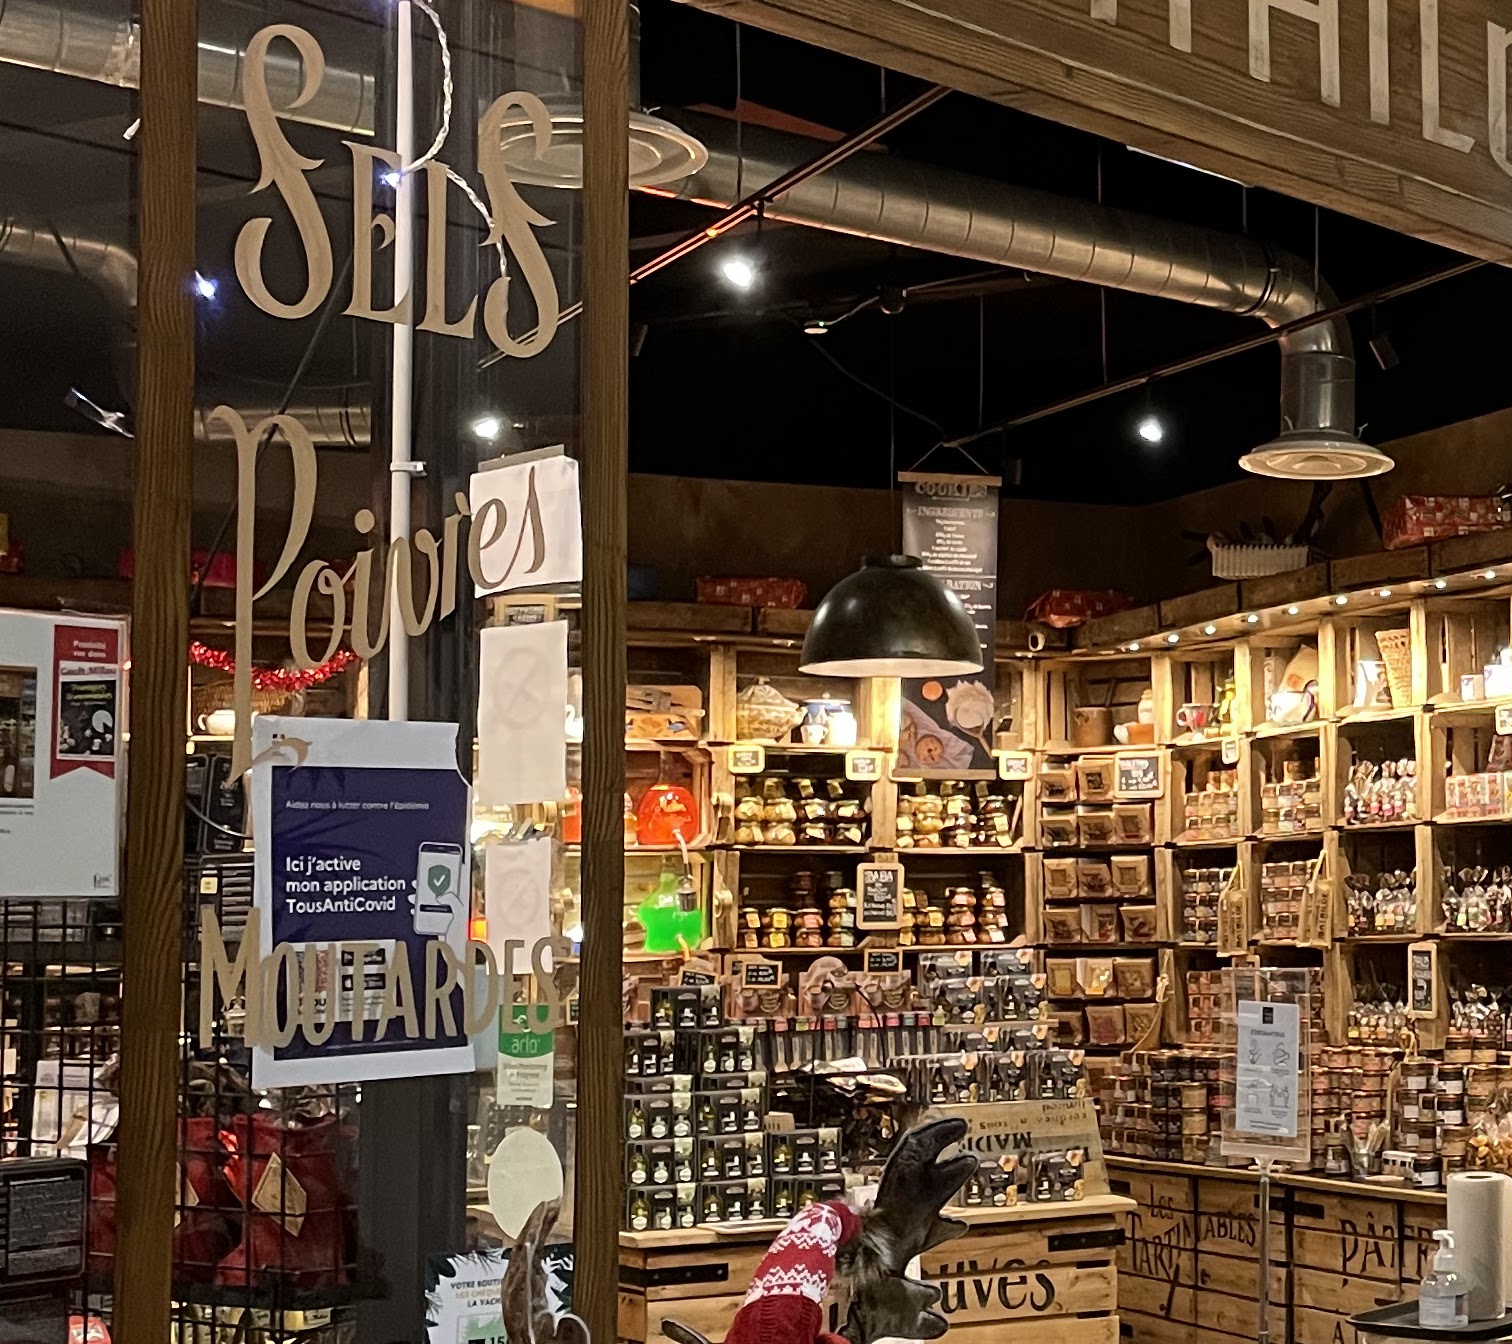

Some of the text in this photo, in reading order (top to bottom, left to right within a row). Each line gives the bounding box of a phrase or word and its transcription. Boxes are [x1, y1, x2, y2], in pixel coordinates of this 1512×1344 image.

[235, 23, 560, 359] SELS
[915, 482, 988, 498] COOKIES
[209, 404, 548, 783] Poivres
[285, 857, 362, 875] Ici j'active
[285, 876, 406, 895] mon application
[285, 896, 397, 914] TousAntiCovid
[199, 905, 566, 1050] MOUTARDES
[511, 1036, 538, 1054] arlo
[1149, 1183, 1174, 1220] Les
[1339, 1211, 1438, 1288] PÂTE
[450, 1278, 502, 1290] VOTRE BOUTI
[480, 1298, 502, 1307] VACH
